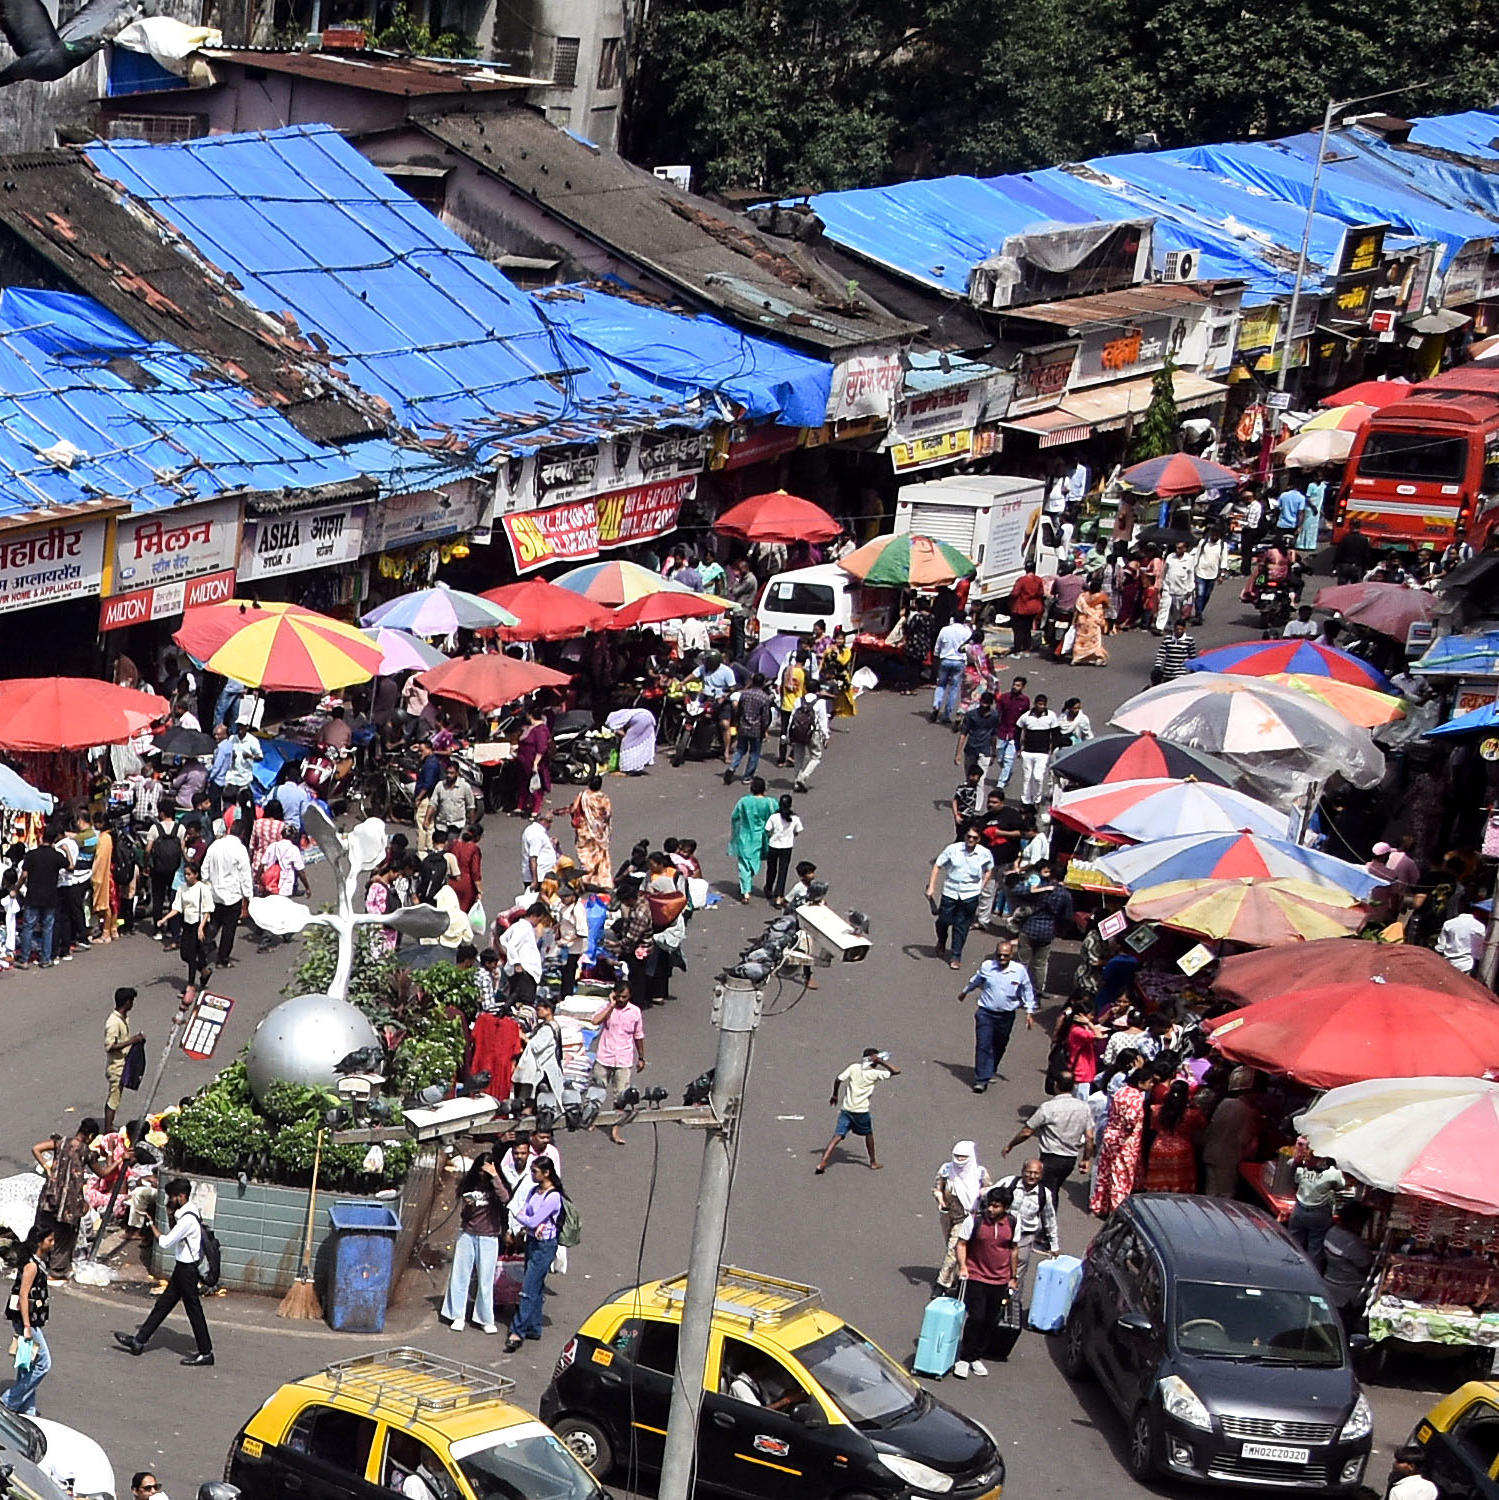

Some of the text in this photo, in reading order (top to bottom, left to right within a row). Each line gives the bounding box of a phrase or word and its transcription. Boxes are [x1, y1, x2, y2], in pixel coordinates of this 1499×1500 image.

[133, 519, 214, 560] मिलन
[258, 519, 300, 554] ASHA
[311, 514, 345, 541] आशा
[151, 554, 190, 574] स्टील सेंटर
[11, 589, 32, 602] HOME
[40, 580, 83, 597] APPLIANCES
[189, 578, 230, 602] MILTON
[105, 598, 147, 625] MILTON
